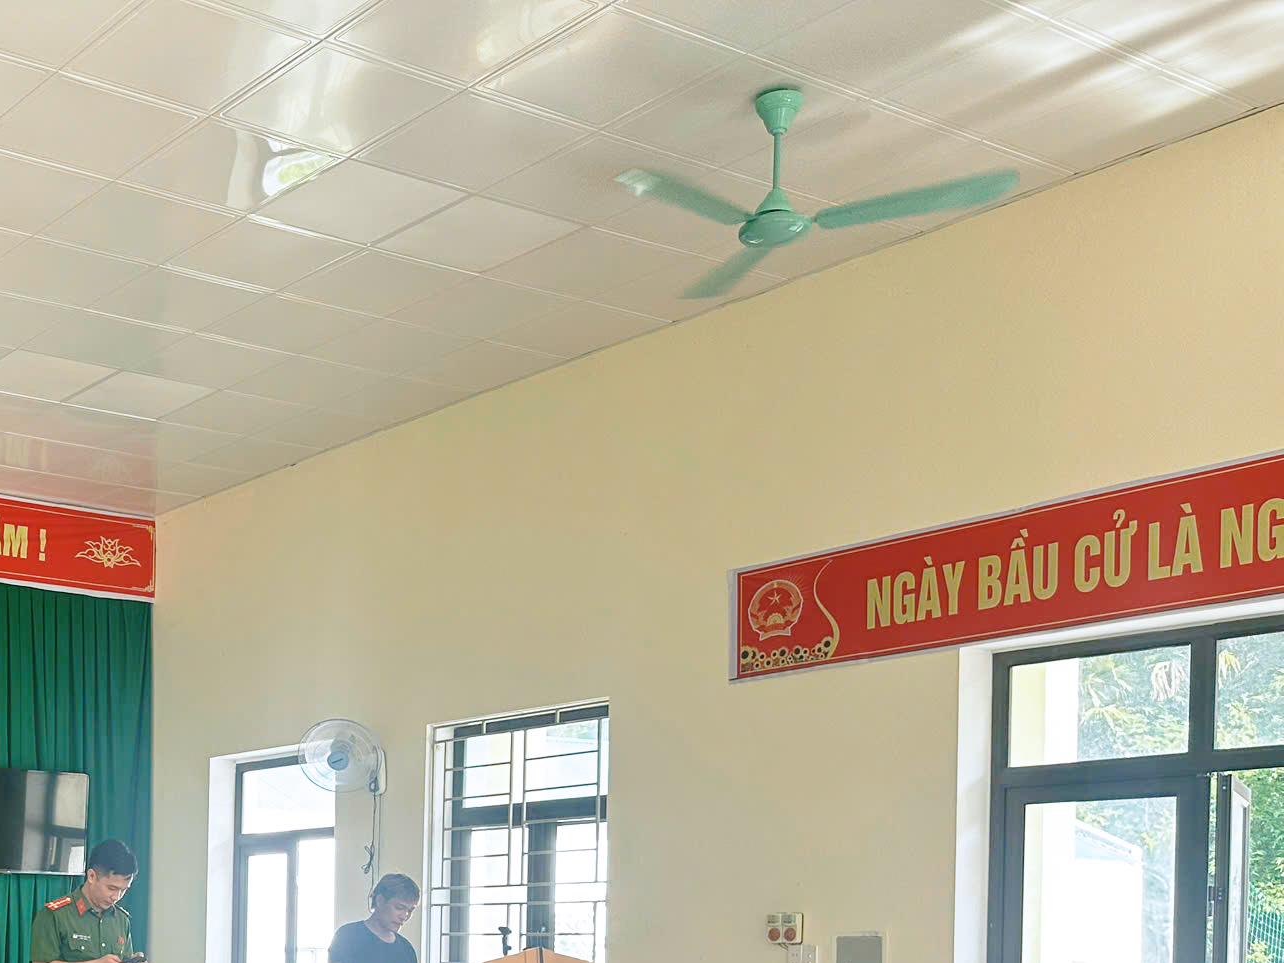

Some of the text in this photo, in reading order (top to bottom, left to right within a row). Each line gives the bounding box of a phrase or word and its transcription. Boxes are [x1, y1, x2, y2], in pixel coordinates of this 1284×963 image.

[39, 529, 46, 561] !
[867, 556, 965, 629] NGÀY
[978, 529, 1058, 610] BẦU
[1075, 509, 1137, 592] CỬ
[1148, 503, 1203, 580] LÀ
